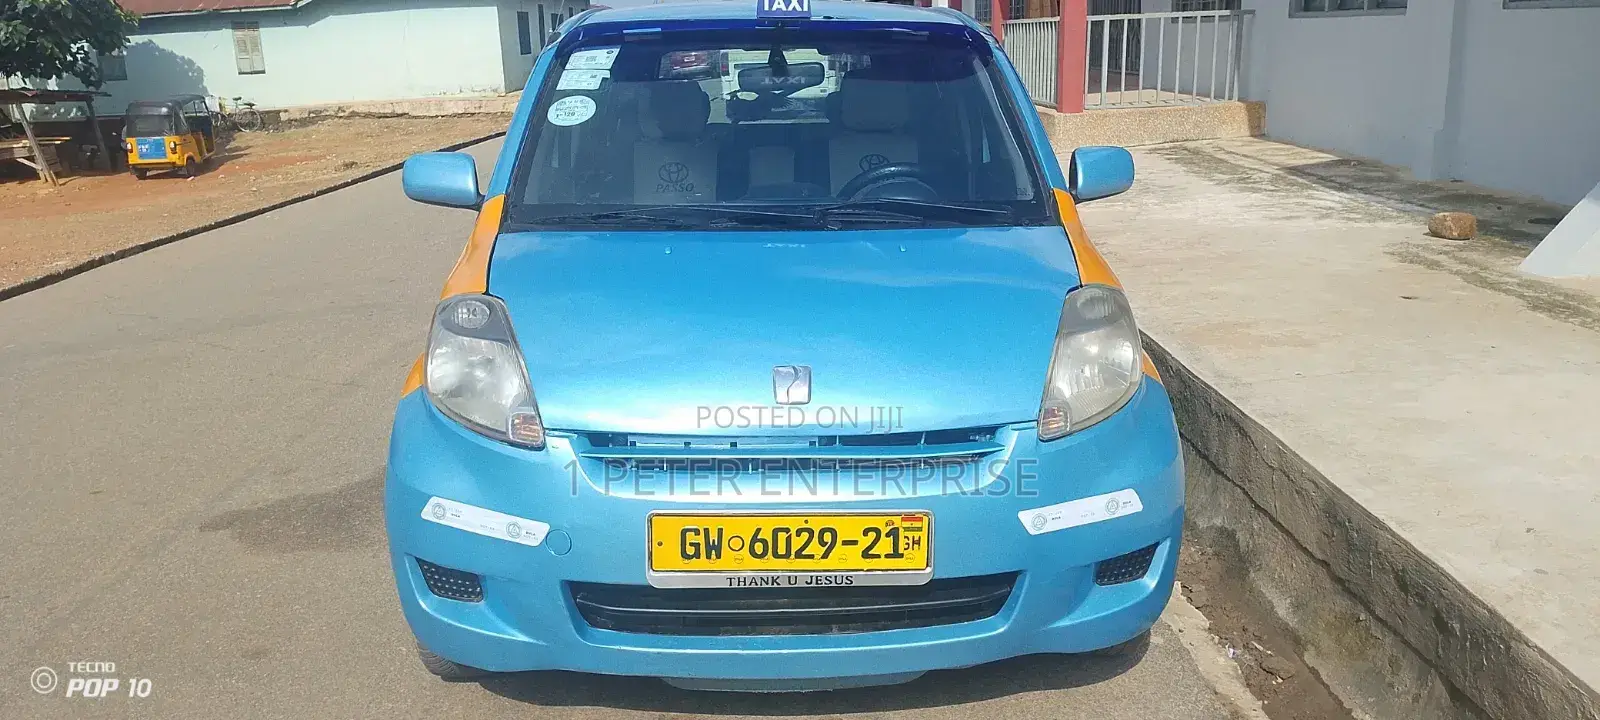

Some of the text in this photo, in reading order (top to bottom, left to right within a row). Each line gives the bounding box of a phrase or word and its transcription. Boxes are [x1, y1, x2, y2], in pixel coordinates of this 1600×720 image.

[763, 0, 808, 12] TAXI
[656, 182, 695, 193] PASSO
[680, 525, 905, 560] GW 6029-21
[726, 575, 854, 587] THANK U JESUS
